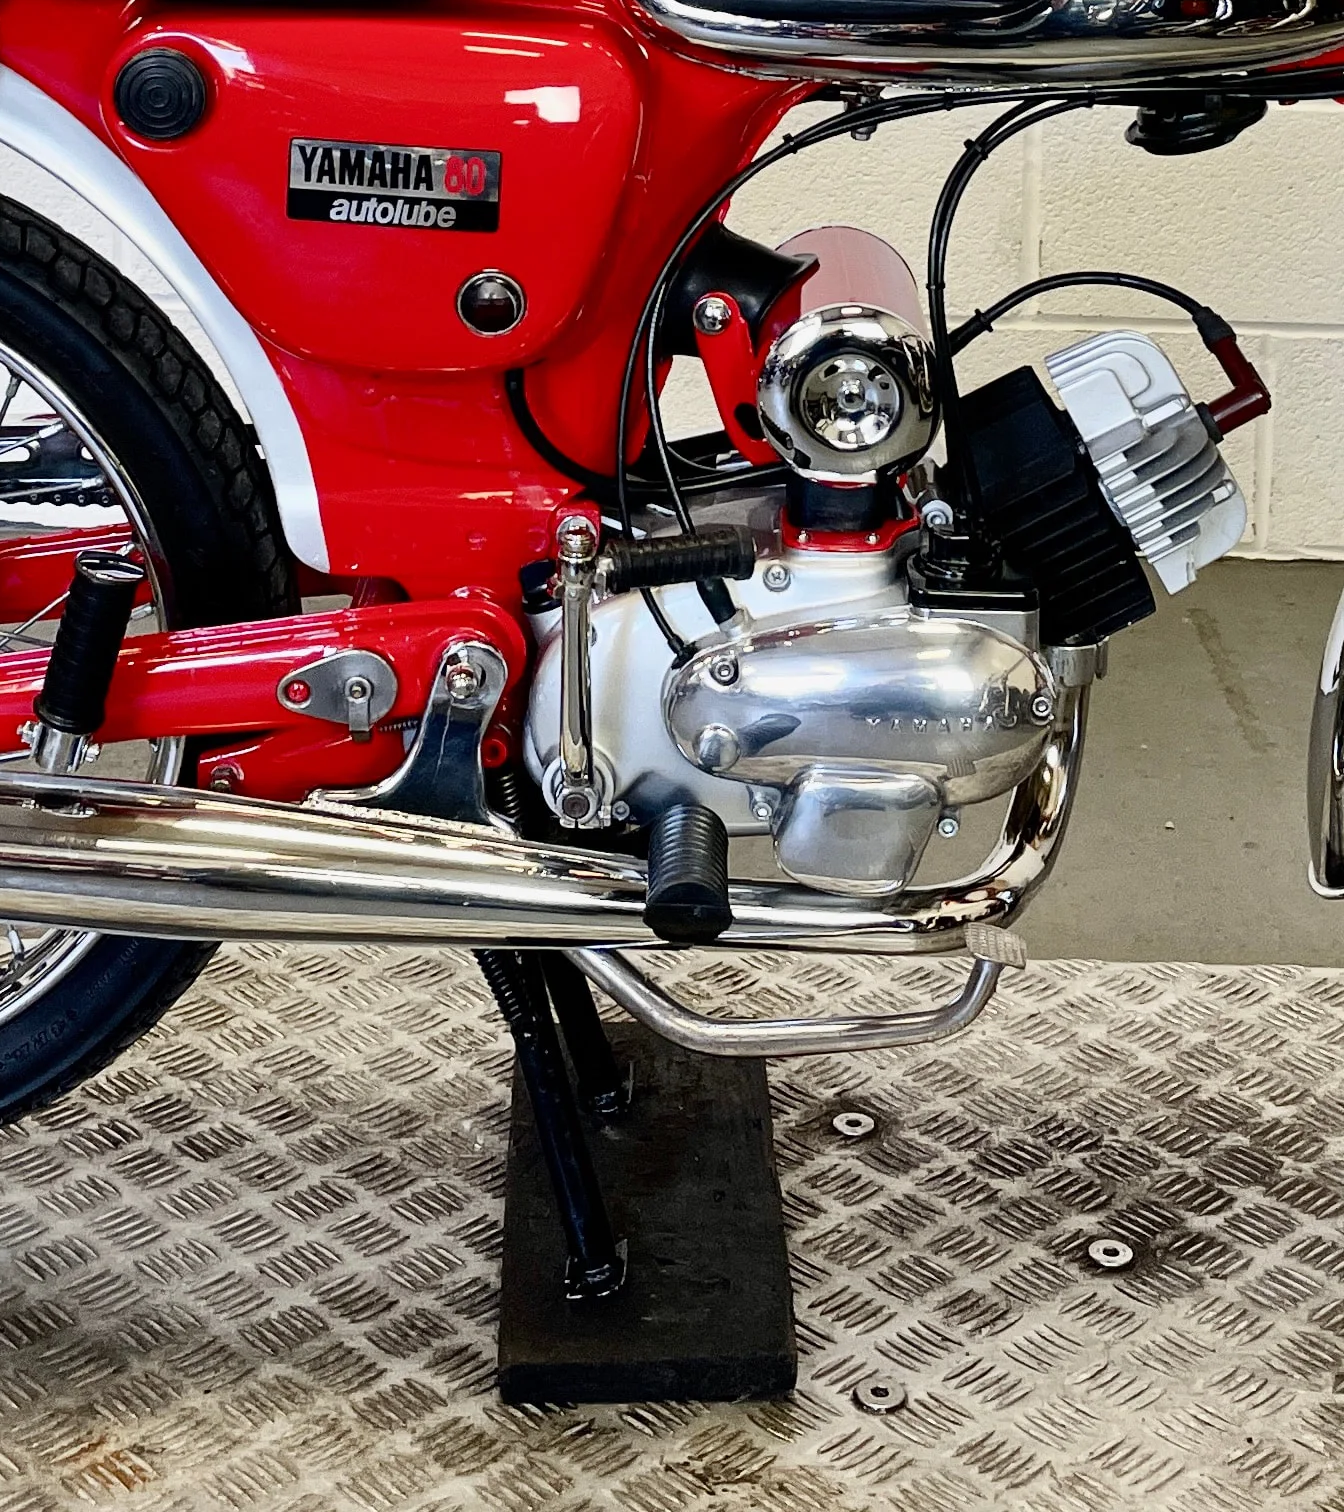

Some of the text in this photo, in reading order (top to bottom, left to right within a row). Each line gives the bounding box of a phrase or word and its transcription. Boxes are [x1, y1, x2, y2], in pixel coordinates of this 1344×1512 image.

[297, 145, 488, 197] YAMAHA 80
[329, 197, 457, 228] autolube
